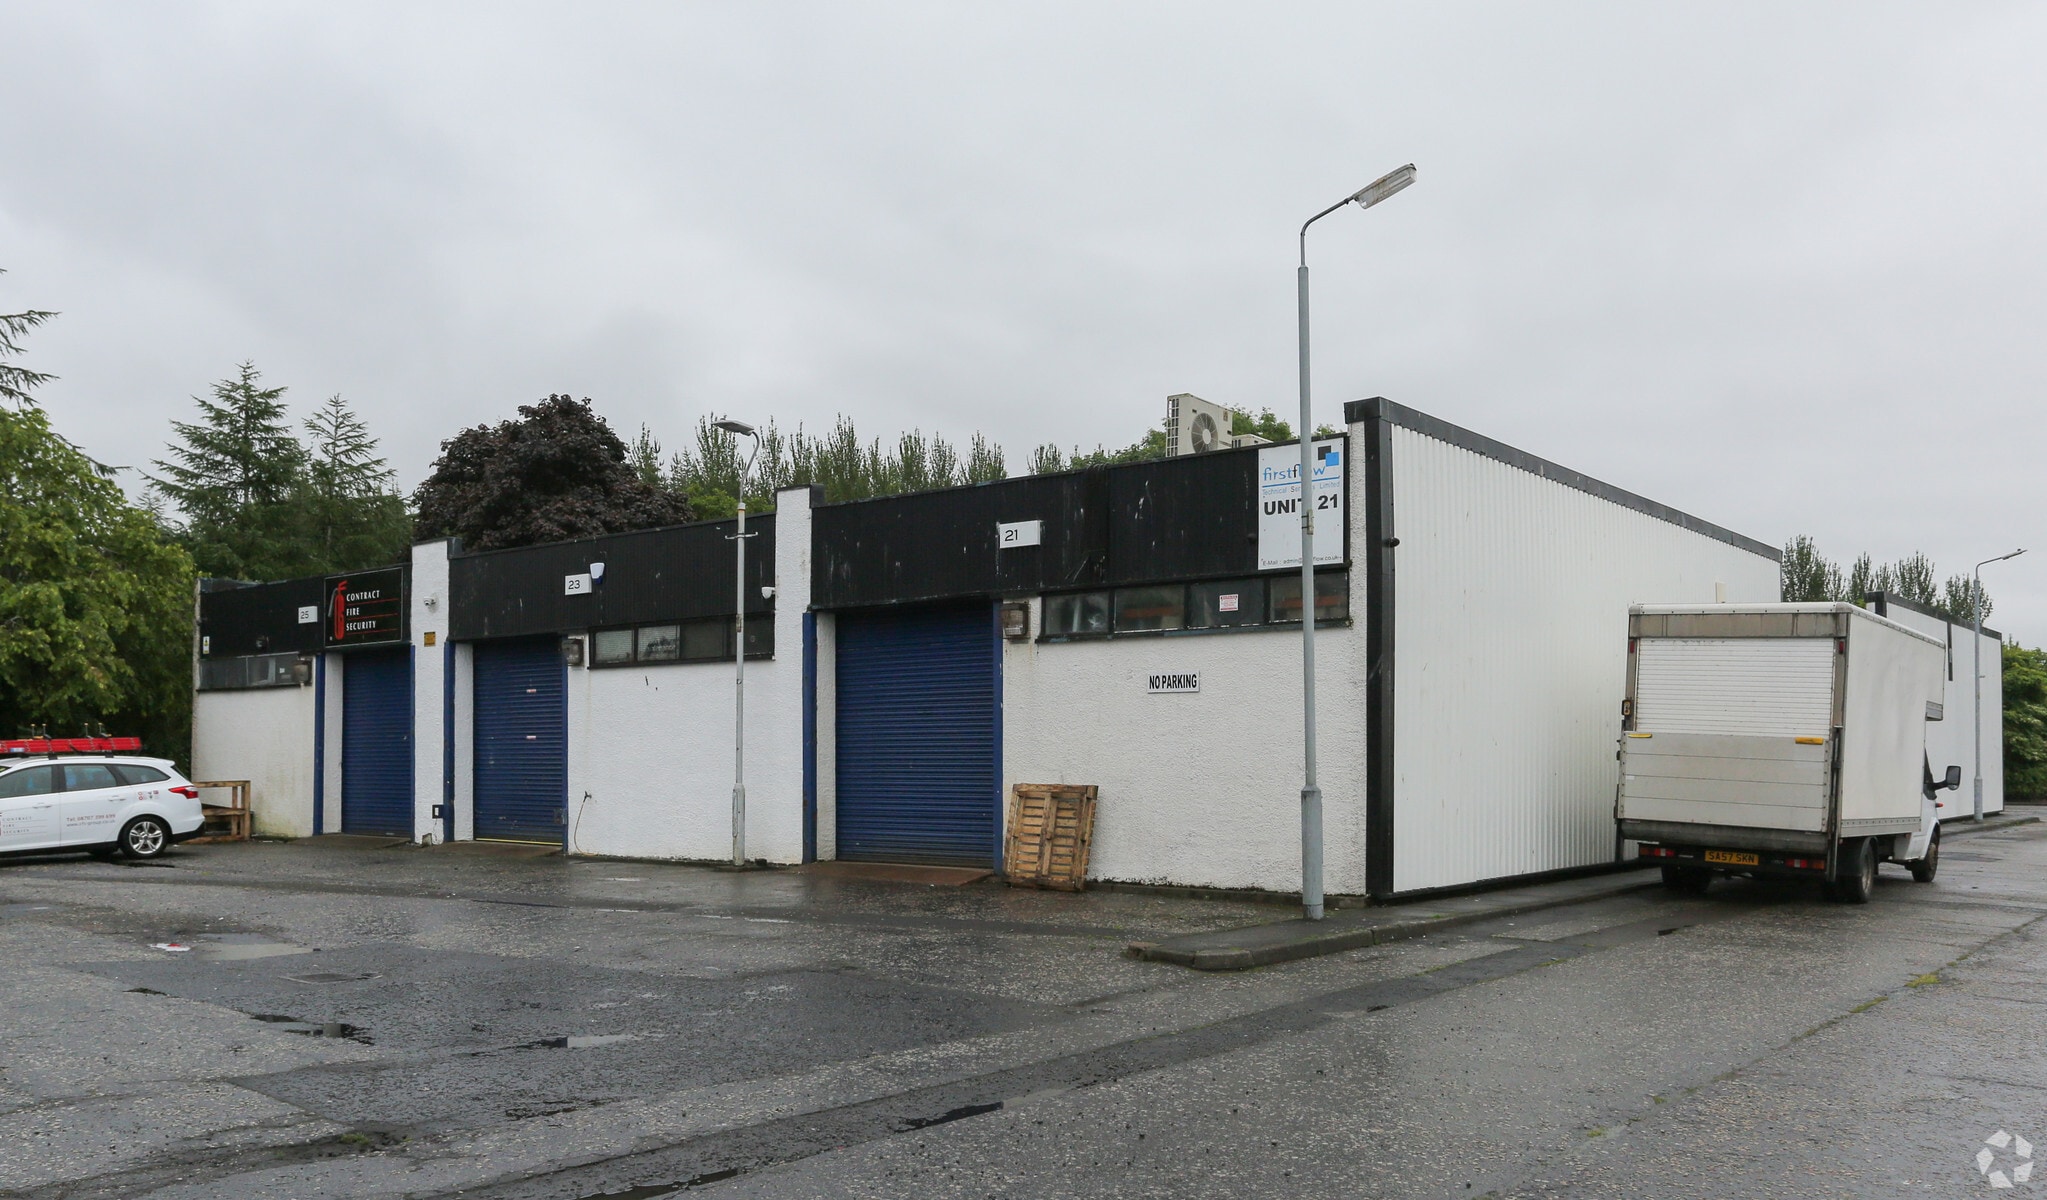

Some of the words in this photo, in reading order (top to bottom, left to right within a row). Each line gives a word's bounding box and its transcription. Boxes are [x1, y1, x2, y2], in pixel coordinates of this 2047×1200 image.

[1263, 463, 1326, 481] firstflw
[1262, 486, 1287, 496] Technical
[1290, 483, 1315, 493] Sers
[1319, 481, 1340, 490] Limited
[1318, 493, 1338, 510] 21
[1004, 529, 1018, 542] 21
[568, 579, 581, 590] 23
[346, 590, 380, 602] CONTRACT
[300, 610, 310, 620] 25
[346, 607, 360, 617] FIRE
[346, 620, 377, 632] SECURITY
[1149, 675, 1161, 690] NO
[1161, 673, 1197, 689] PARKING
[1708, 851, 1733, 862] SA57
[1736, 853, 1755, 863] SKN
